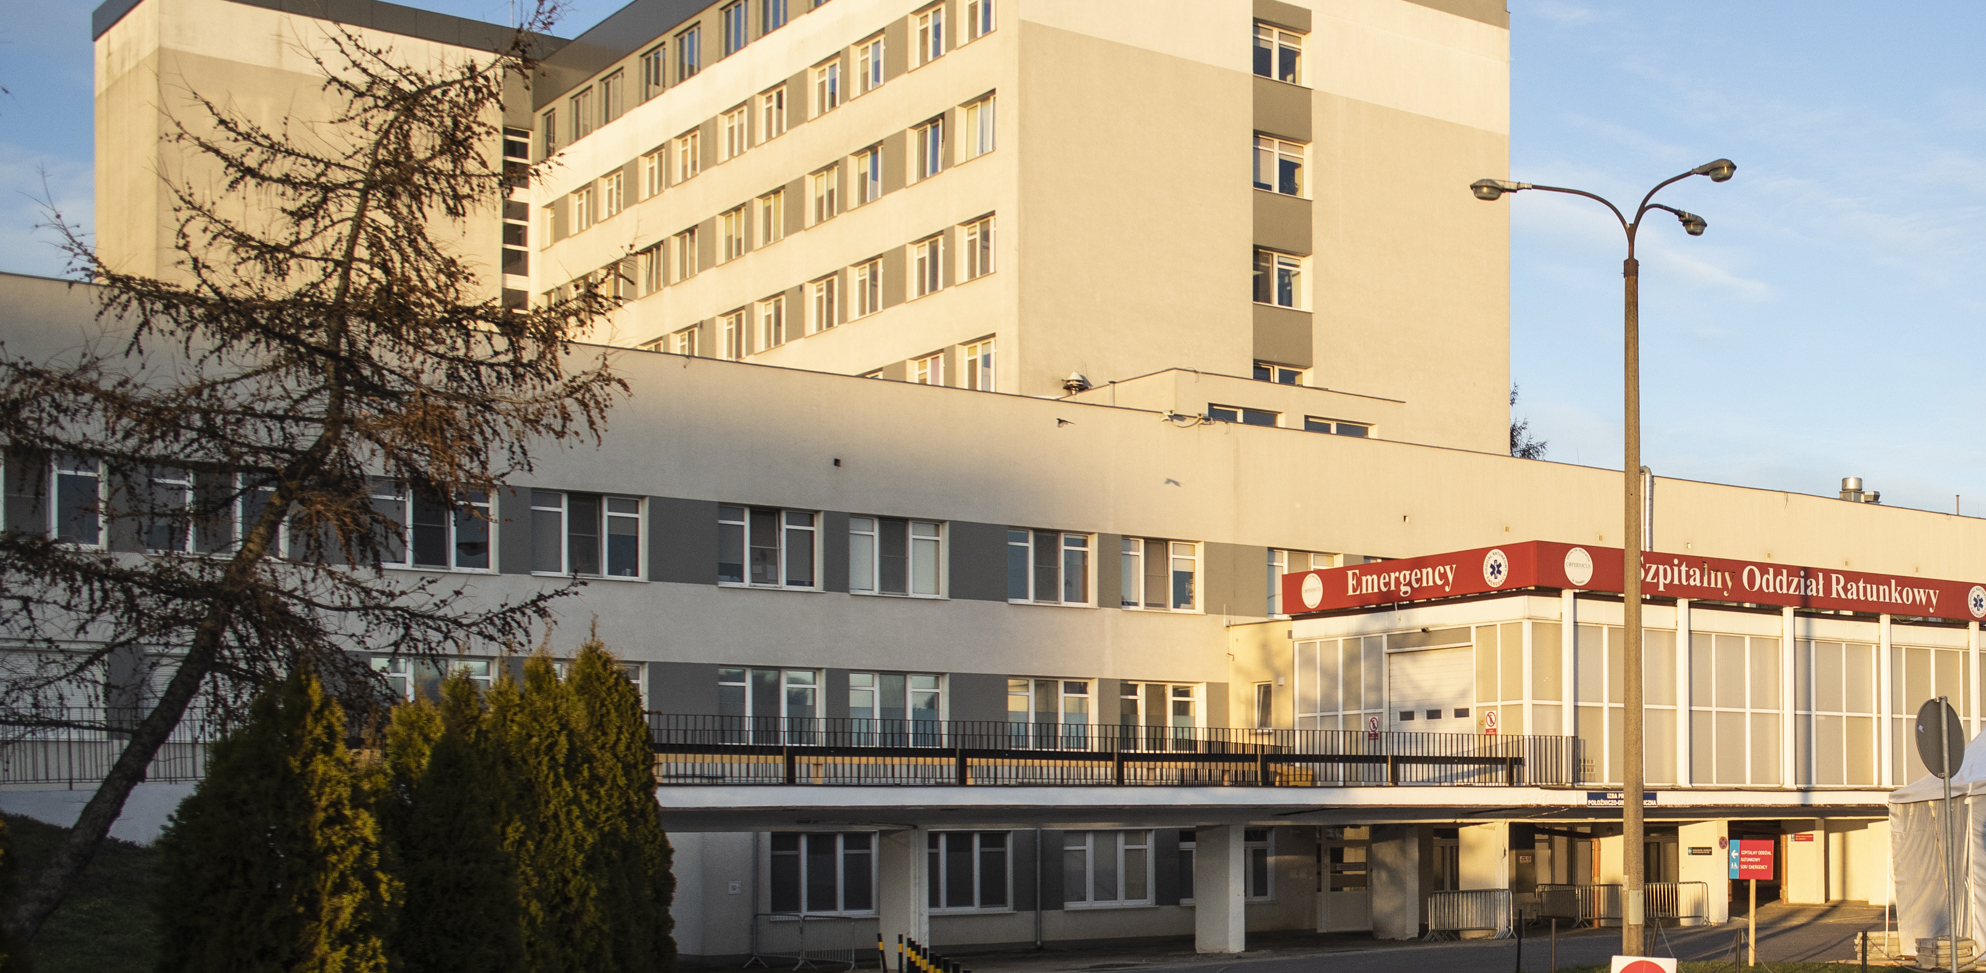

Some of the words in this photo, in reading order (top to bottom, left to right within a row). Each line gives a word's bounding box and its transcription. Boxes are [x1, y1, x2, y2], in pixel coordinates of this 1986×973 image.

[1346, 564, 1457, 597] Emergency
[1742, 564, 1825, 598] Oddział
[1830, 573, 1939, 613] Ratunkowy
